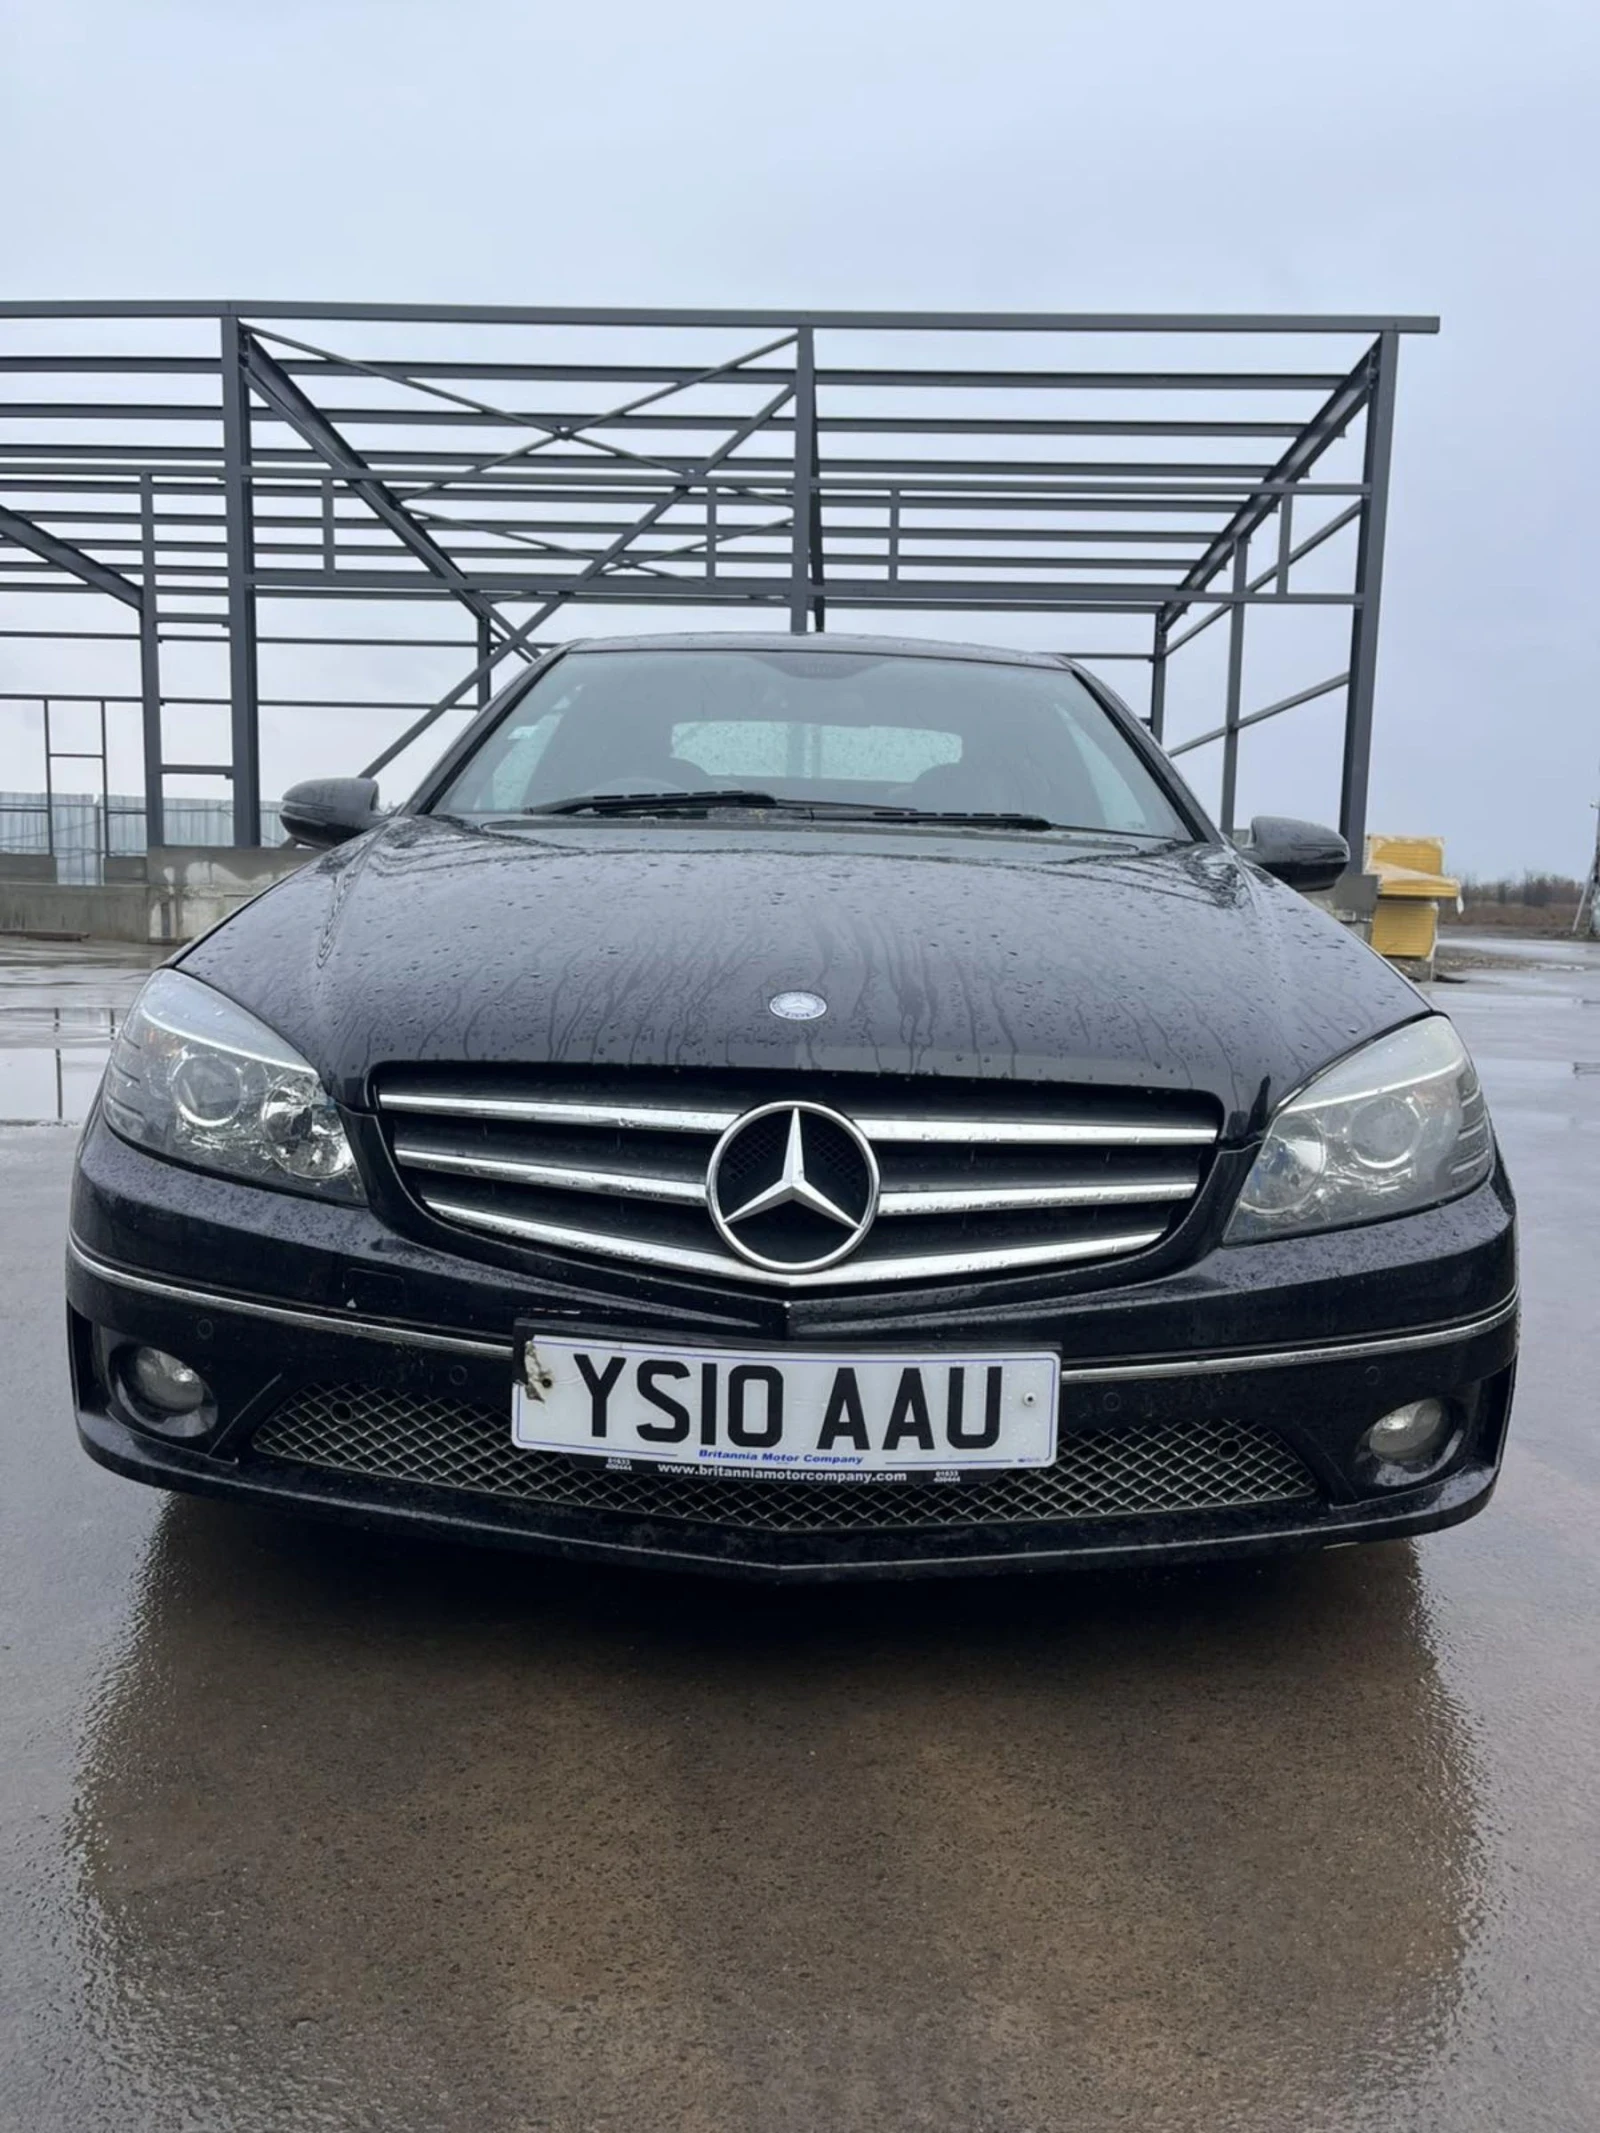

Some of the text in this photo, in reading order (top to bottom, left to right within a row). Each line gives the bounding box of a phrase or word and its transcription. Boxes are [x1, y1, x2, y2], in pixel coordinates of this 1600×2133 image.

[816, 1366, 1003, 1450] AAU
[699, 1449, 864, 1465] Britannia Motor Company
[657, 1463, 907, 1484] www.britanniamotorcompany.com
